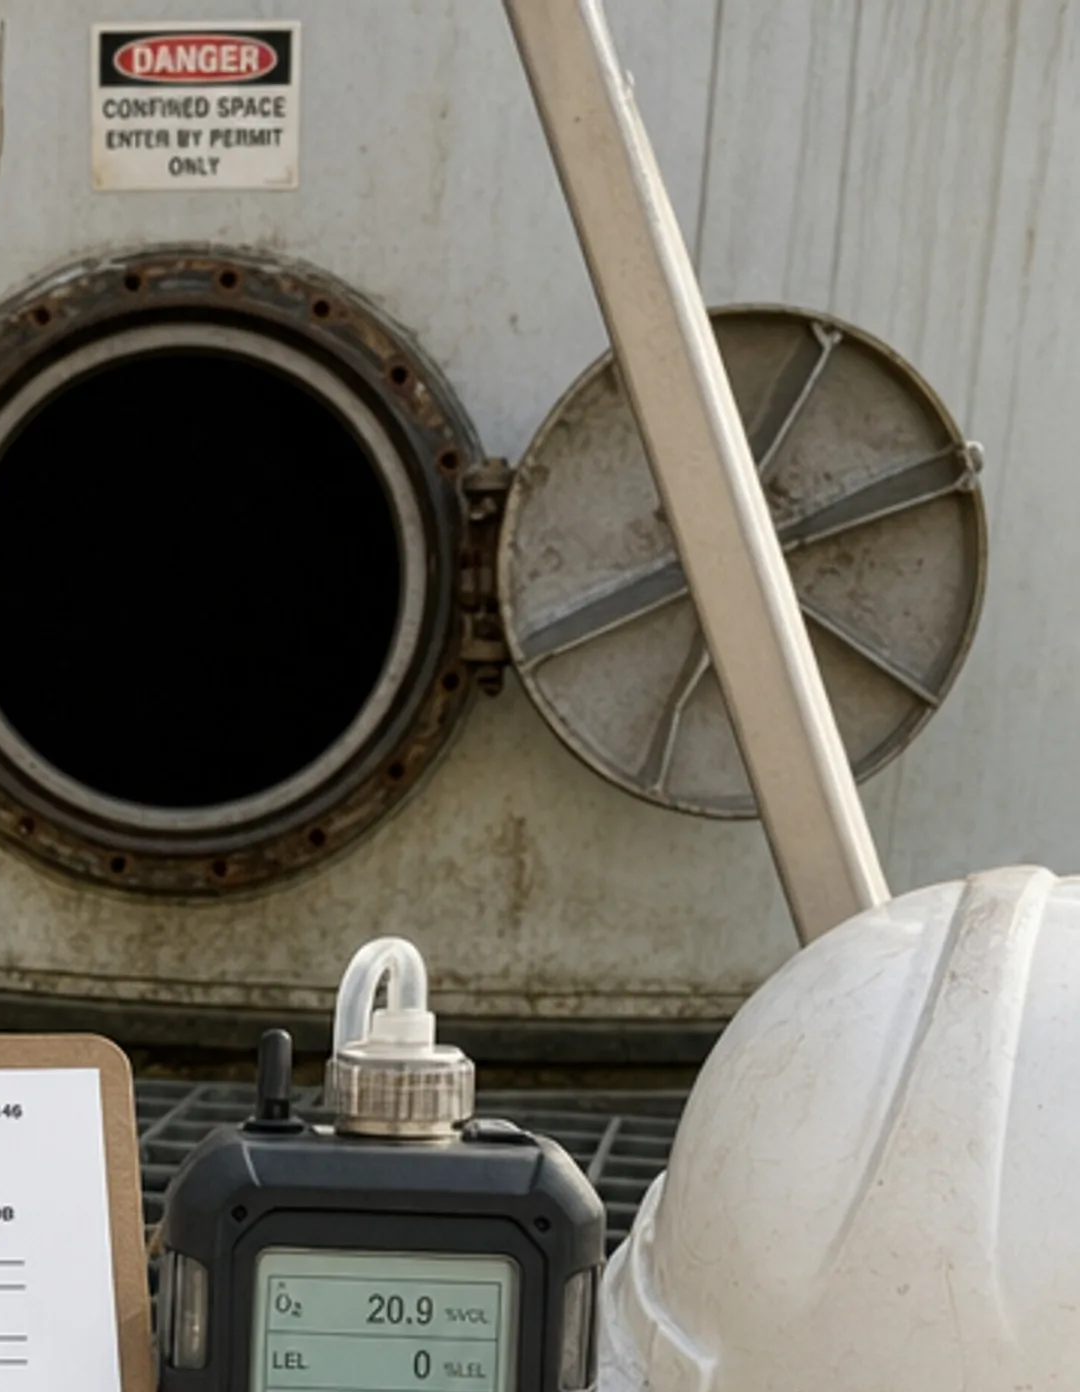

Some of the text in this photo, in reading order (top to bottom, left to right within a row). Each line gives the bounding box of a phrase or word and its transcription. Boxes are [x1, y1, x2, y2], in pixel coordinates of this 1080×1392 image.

[132, 45, 260, 74] DANGER
[102, 96, 286, 119] CONFINED SPACE
[105, 128, 283, 150] ENTER BY PERMIT
[168, 156, 221, 176] ONLY
[366, 1294, 433, 1325] 20.9
[272, 1352, 308, 1370] LEL
[414, 1350, 431, 1380] 0
